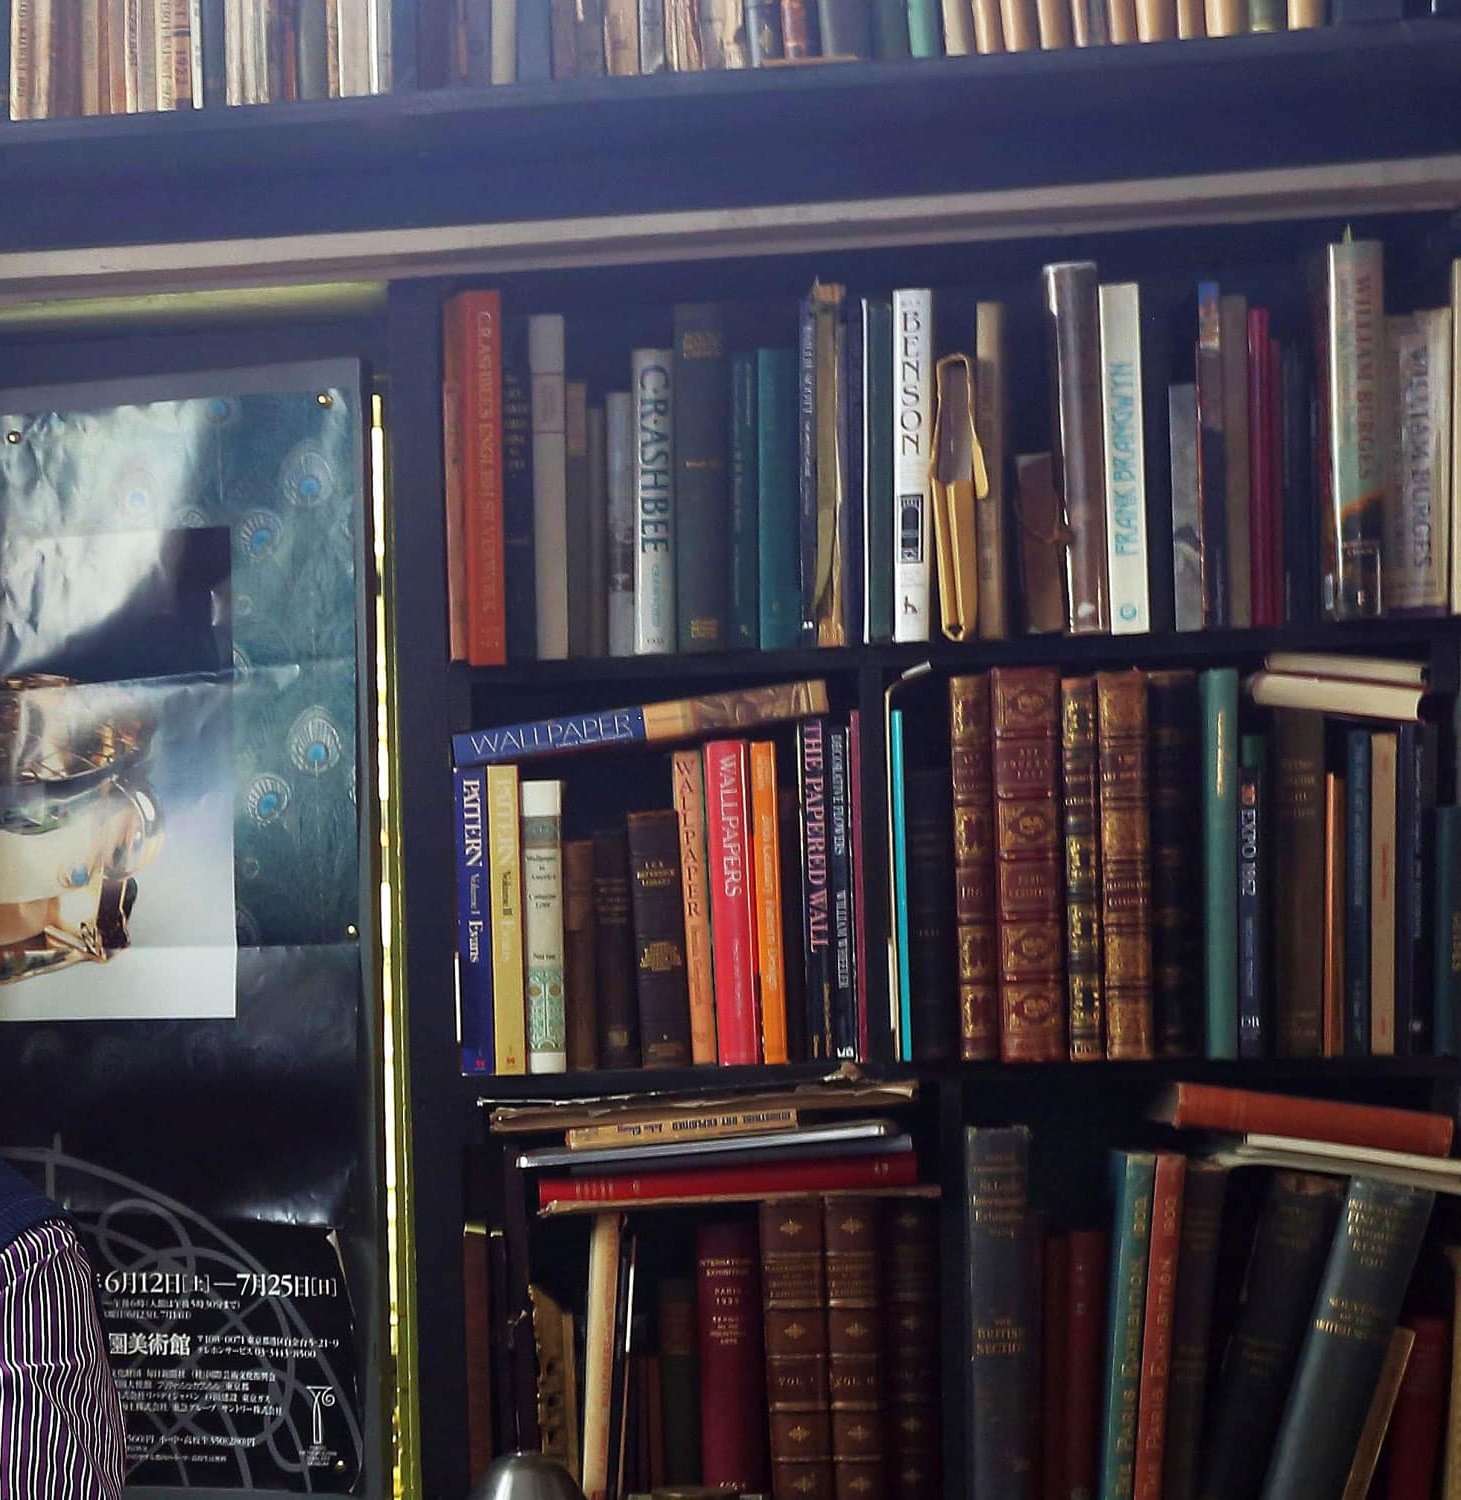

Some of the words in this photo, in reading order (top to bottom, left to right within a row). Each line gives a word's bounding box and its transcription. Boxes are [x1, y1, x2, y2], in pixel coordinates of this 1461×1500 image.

[1353, 274, 1373, 381] WILLIAM
[900, 310, 922, 457] BENSON
[1406, 344, 1431, 460] WILLIAM
[1109, 358, 1134, 482] BRANGWYN
[1356, 390, 1374, 480] BURGES
[1113, 488, 1136, 556] FRANK
[1410, 466, 1432, 568] BURGES
[469, 712, 634, 757] WALLPAPER
[802, 720, 822, 771] THE
[462, 779, 482, 867] PATTERN
[496, 778, 515, 866] PATTERN
[675, 758, 705, 917] WALLPAPER
[717, 753, 742, 897] WALLPAPERS
[804, 775, 826, 885] PAPERED
[832, 805, 845, 856] FLOWERS
[1240, 808, 1256, 858] EXPO
[469, 872, 480, 907] Volume
[501, 870, 512, 906] Volume
[807, 888, 828, 953] WALL
[835, 889, 846, 937] WILLIAM
[468, 918, 484, 963] Evans
[501, 918, 517, 962] Evans
[108, 1332, 191, 1356] 園美術館
[1119, 1259, 1144, 1377] EXHIBITION
[1148, 1256, 1174, 1377] EXHIBITION
[1115, 1387, 1134, 1451] PARIS
[1144, 1387, 1163, 1450] PARIS
